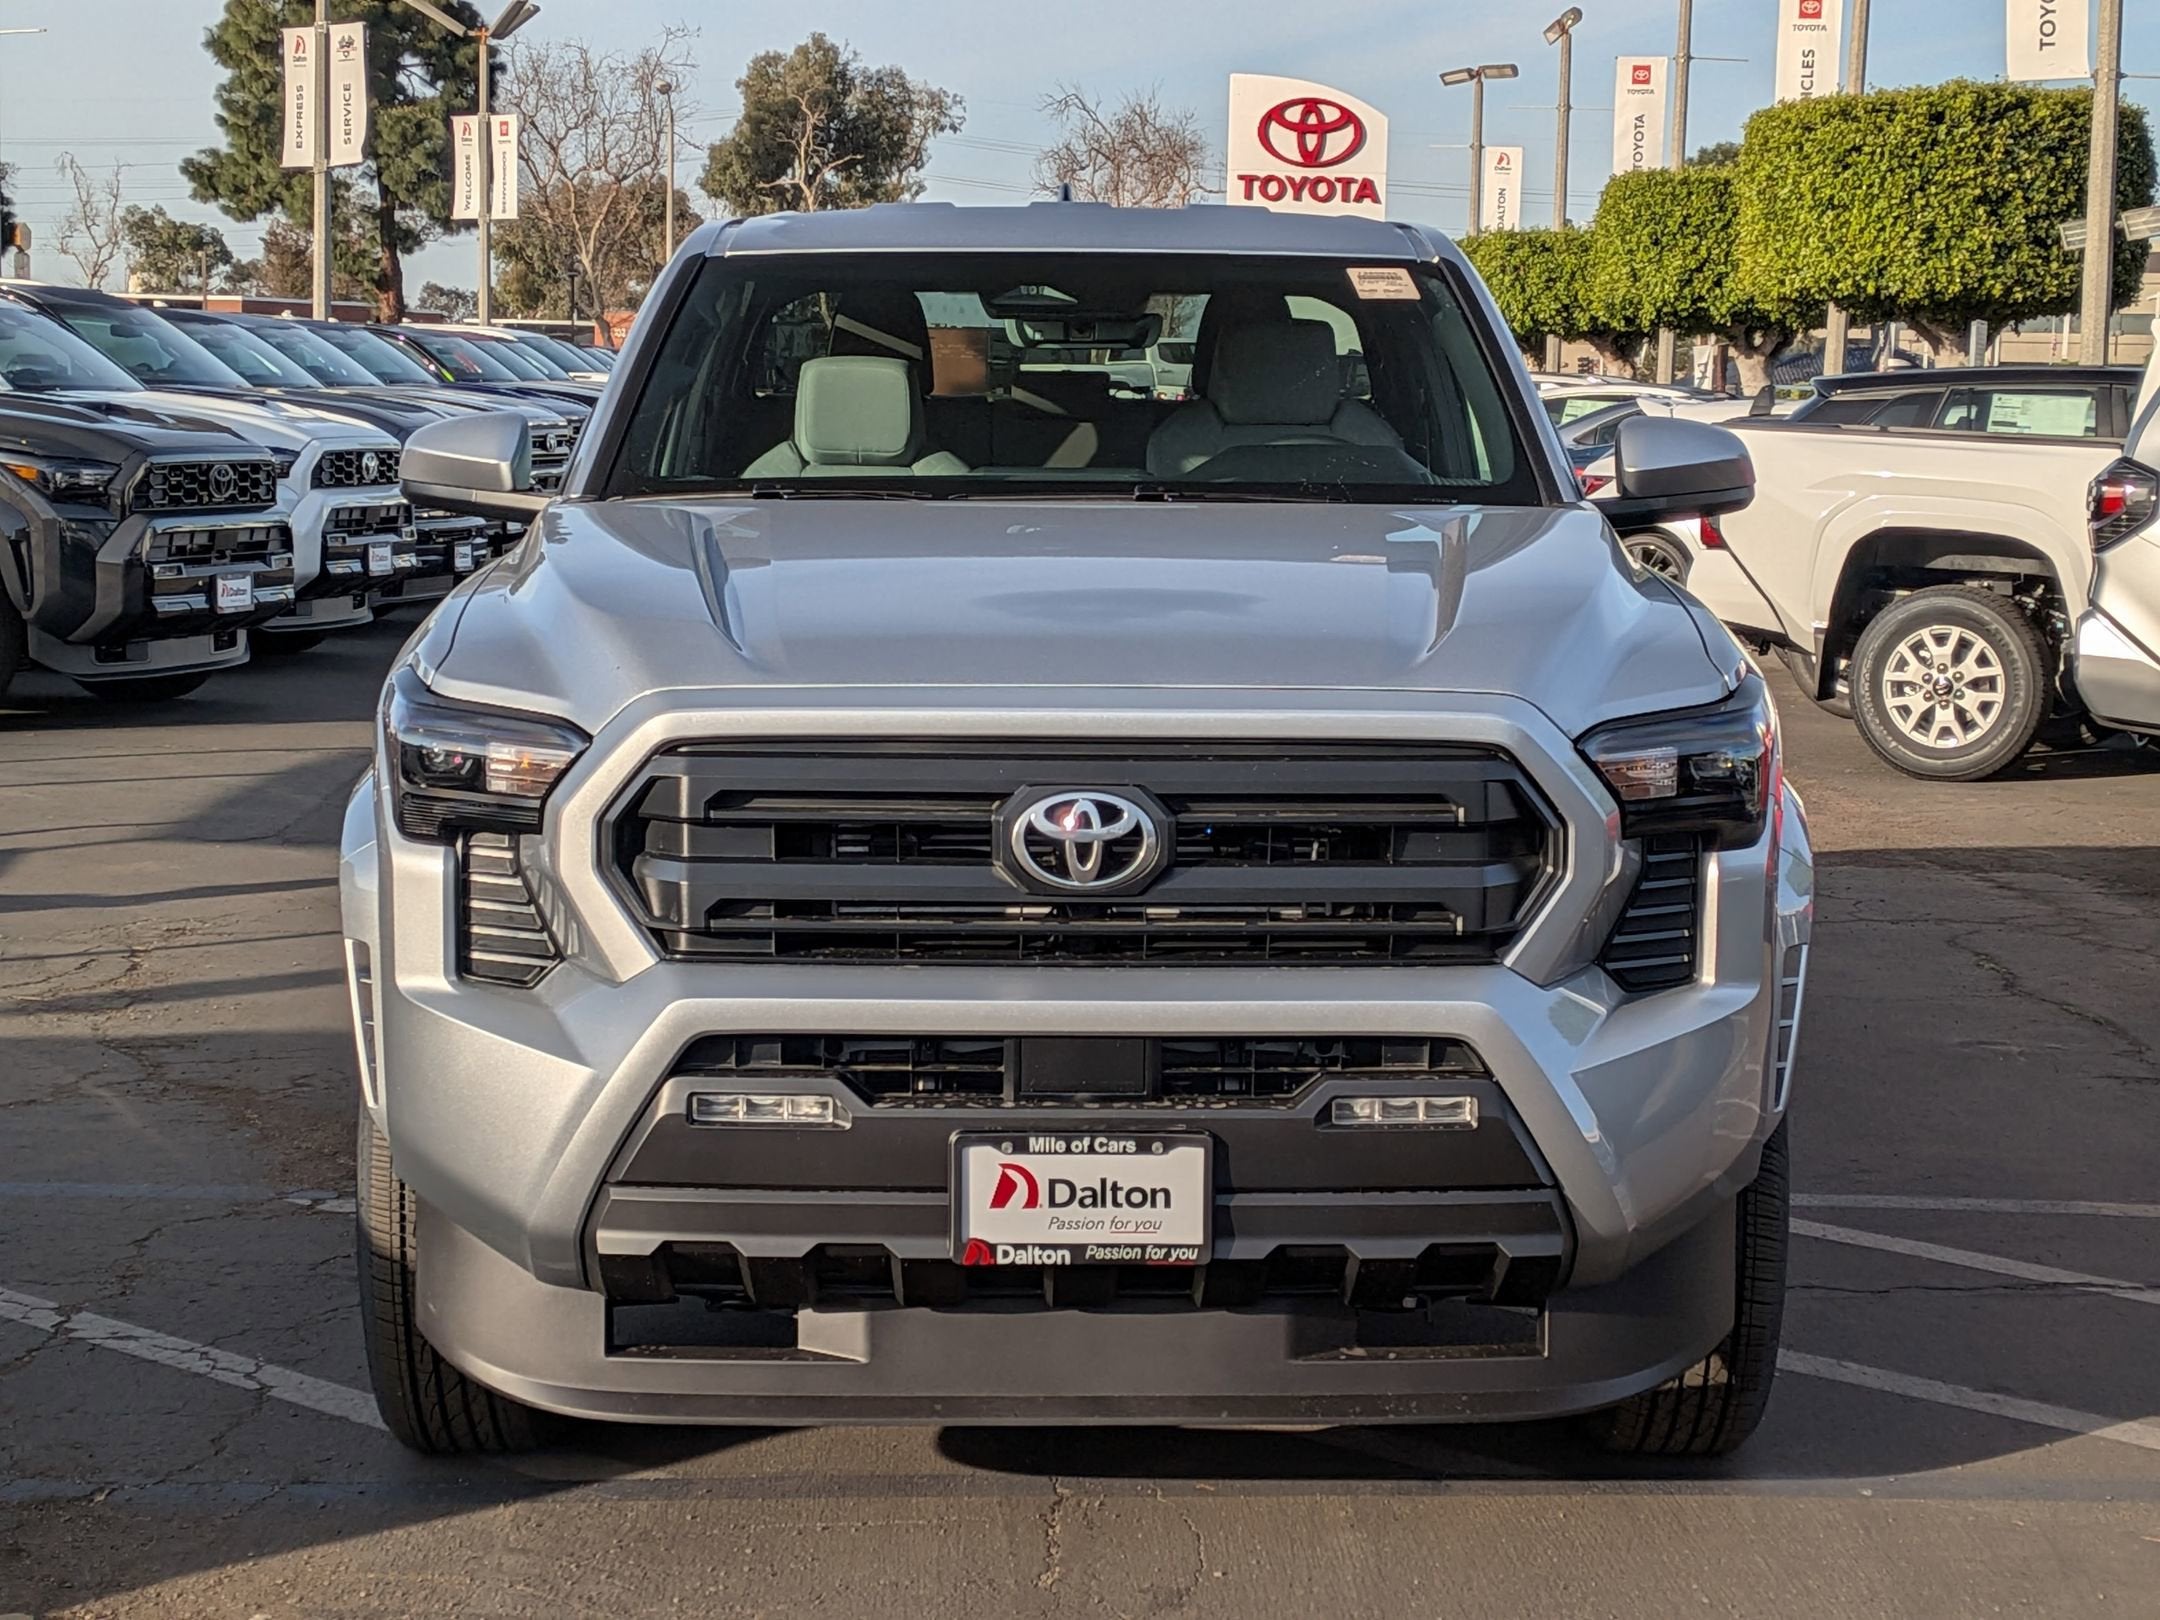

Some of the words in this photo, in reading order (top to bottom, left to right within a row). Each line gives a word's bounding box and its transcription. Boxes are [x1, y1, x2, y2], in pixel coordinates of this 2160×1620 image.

[1792, 24, 1828, 32] TOYOTA
[2039, 0, 2057, 52] TOY
[295, 84, 304, 149] EXPRESS
[342, 83, 352, 145] SERVICE
[463, 154, 472, 211] WELCOME
[1236, 174, 1382, 205] TOYOTA
[1497, 187, 1507, 231] DALTON
[1028, 1136, 1067, 1153] Mile
[1070, 1136, 1091, 1153] of
[1093, 1136, 1137, 1153] Cars
[1047, 1177, 1172, 1209] Dalton
[1047, 1216, 1105, 1230] Passion
[1109, 1216, 1131, 1230] for
[1134, 1220, 1163, 1233] you
[995, 1245, 1071, 1265] Dalton
[1085, 1245, 1142, 1260] Passion
[1145, 1245, 1167, 1260] for
[1168, 1247, 1199, 1263] you
